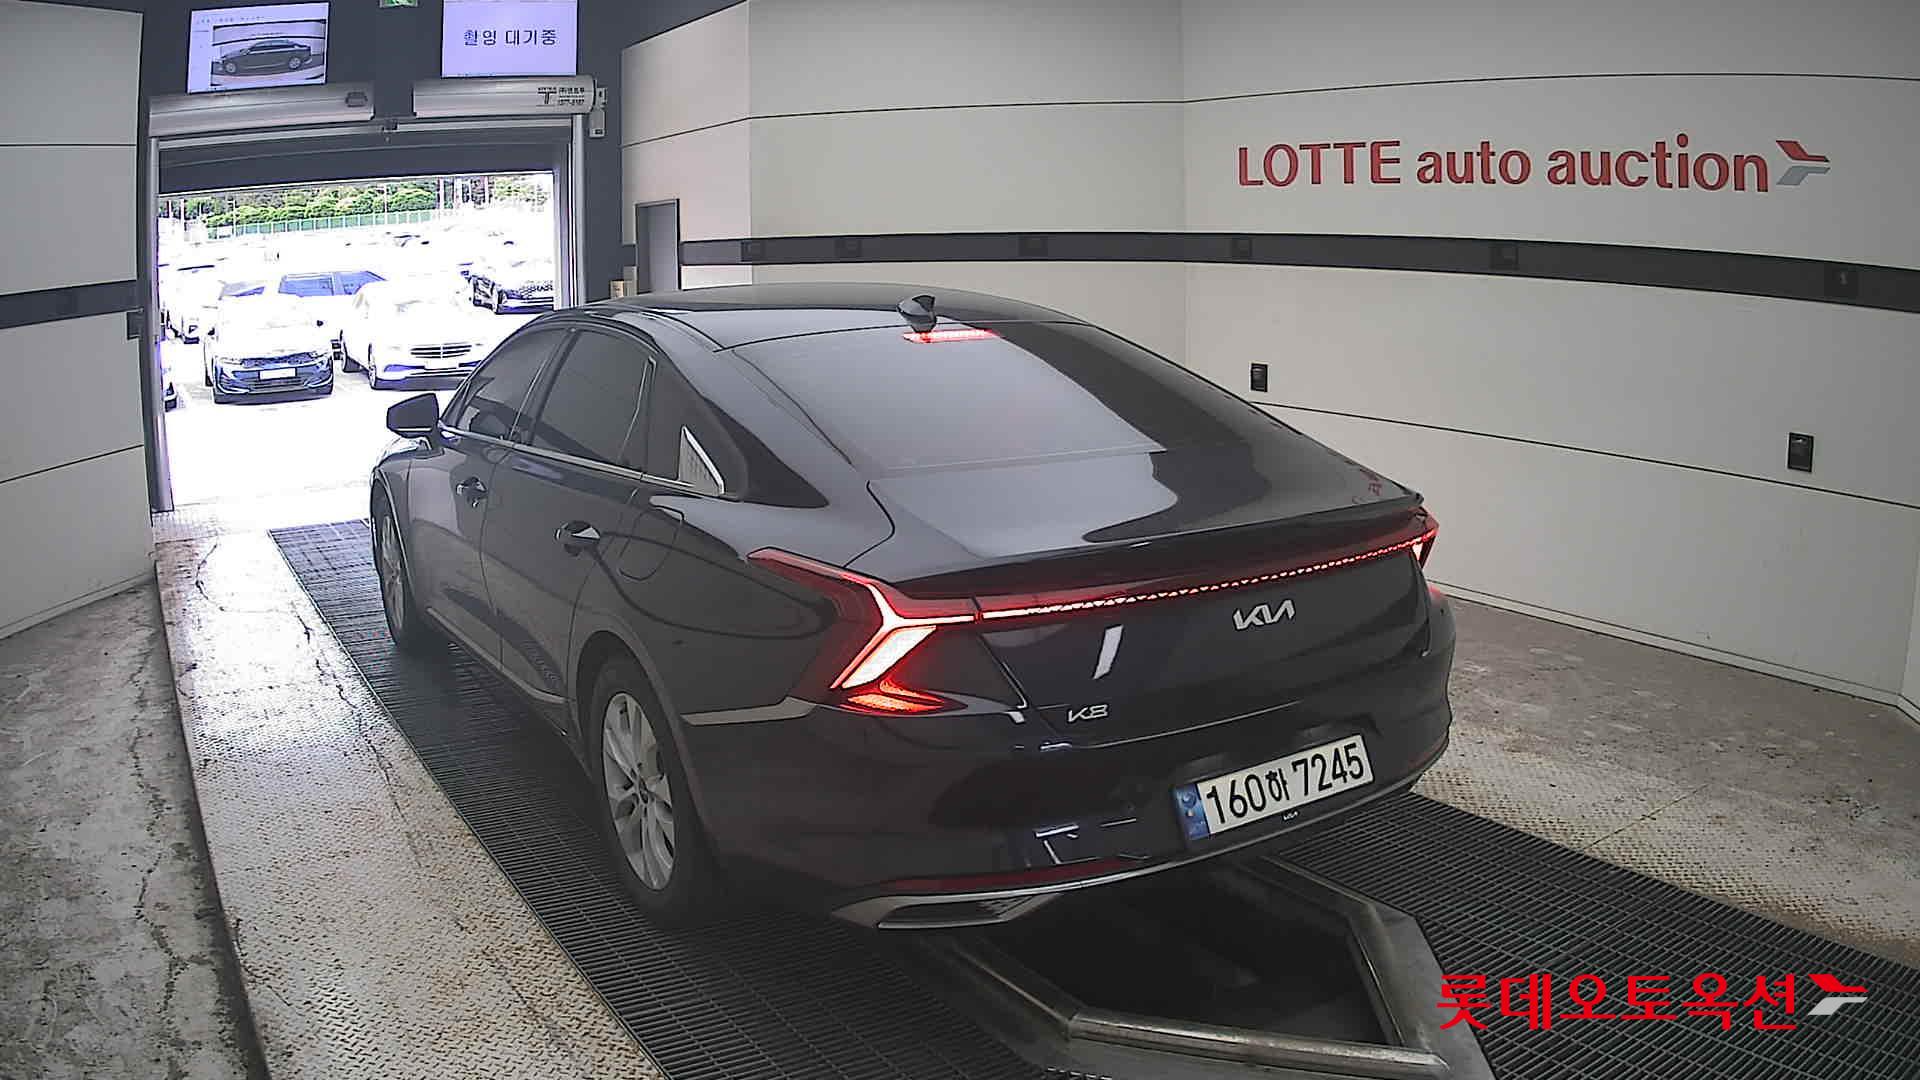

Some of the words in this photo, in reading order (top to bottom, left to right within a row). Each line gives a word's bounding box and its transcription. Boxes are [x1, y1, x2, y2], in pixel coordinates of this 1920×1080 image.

[505, 29, 557, 46] 대기중
[1238, 140, 1400, 187] LOTTE
[1416, 141, 1532, 185] auto
[1547, 134, 1769, 192] auction
[1232, 599, 1296, 631] KIA
[1067, 703, 1109, 723] K8
[1206, 767, 1290, 824] 160하
[1291, 742, 1364, 797] 7245
